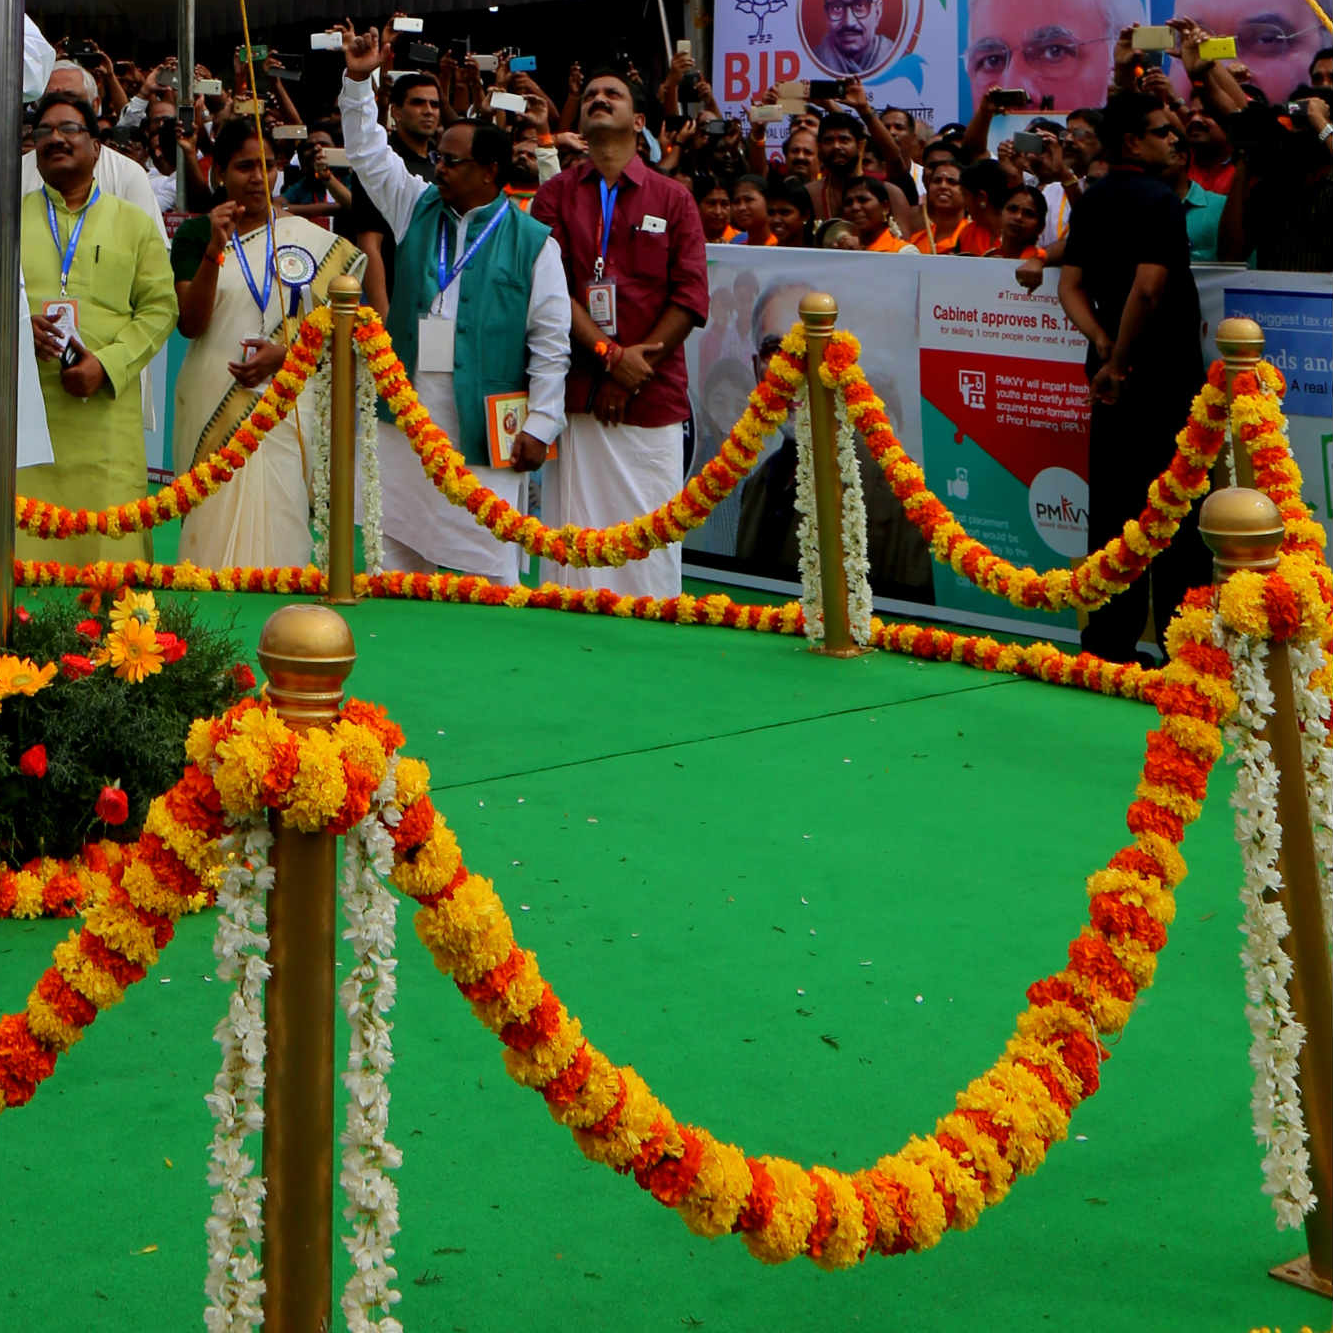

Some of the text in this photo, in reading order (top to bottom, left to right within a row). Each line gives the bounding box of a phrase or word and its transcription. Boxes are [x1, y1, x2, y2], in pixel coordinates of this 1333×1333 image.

[724, 50, 801, 102] BJP
[933, 305, 978, 324] Cabinet
[981, 310, 1037, 329] approves
[1255, 311, 1299, 327] biggest
[1302, 315, 1321, 327] tax
[1002, 332, 1024, 342] people
[1026, 335, 1041, 343] over
[995, 375, 1024, 387] PMKVY
[1026, 379, 1040, 389] will
[1042, 381, 1066, 393] impart
[1291, 379, 1300, 392] A
[1304, 381, 1328, 395] real
[996, 402, 1028, 413] acquired
[1022, 393, 1037, 402] and
[1039, 394, 1063, 406] certify
[996, 413, 1004, 423] of
[1006, 414, 1024, 426] Prior
